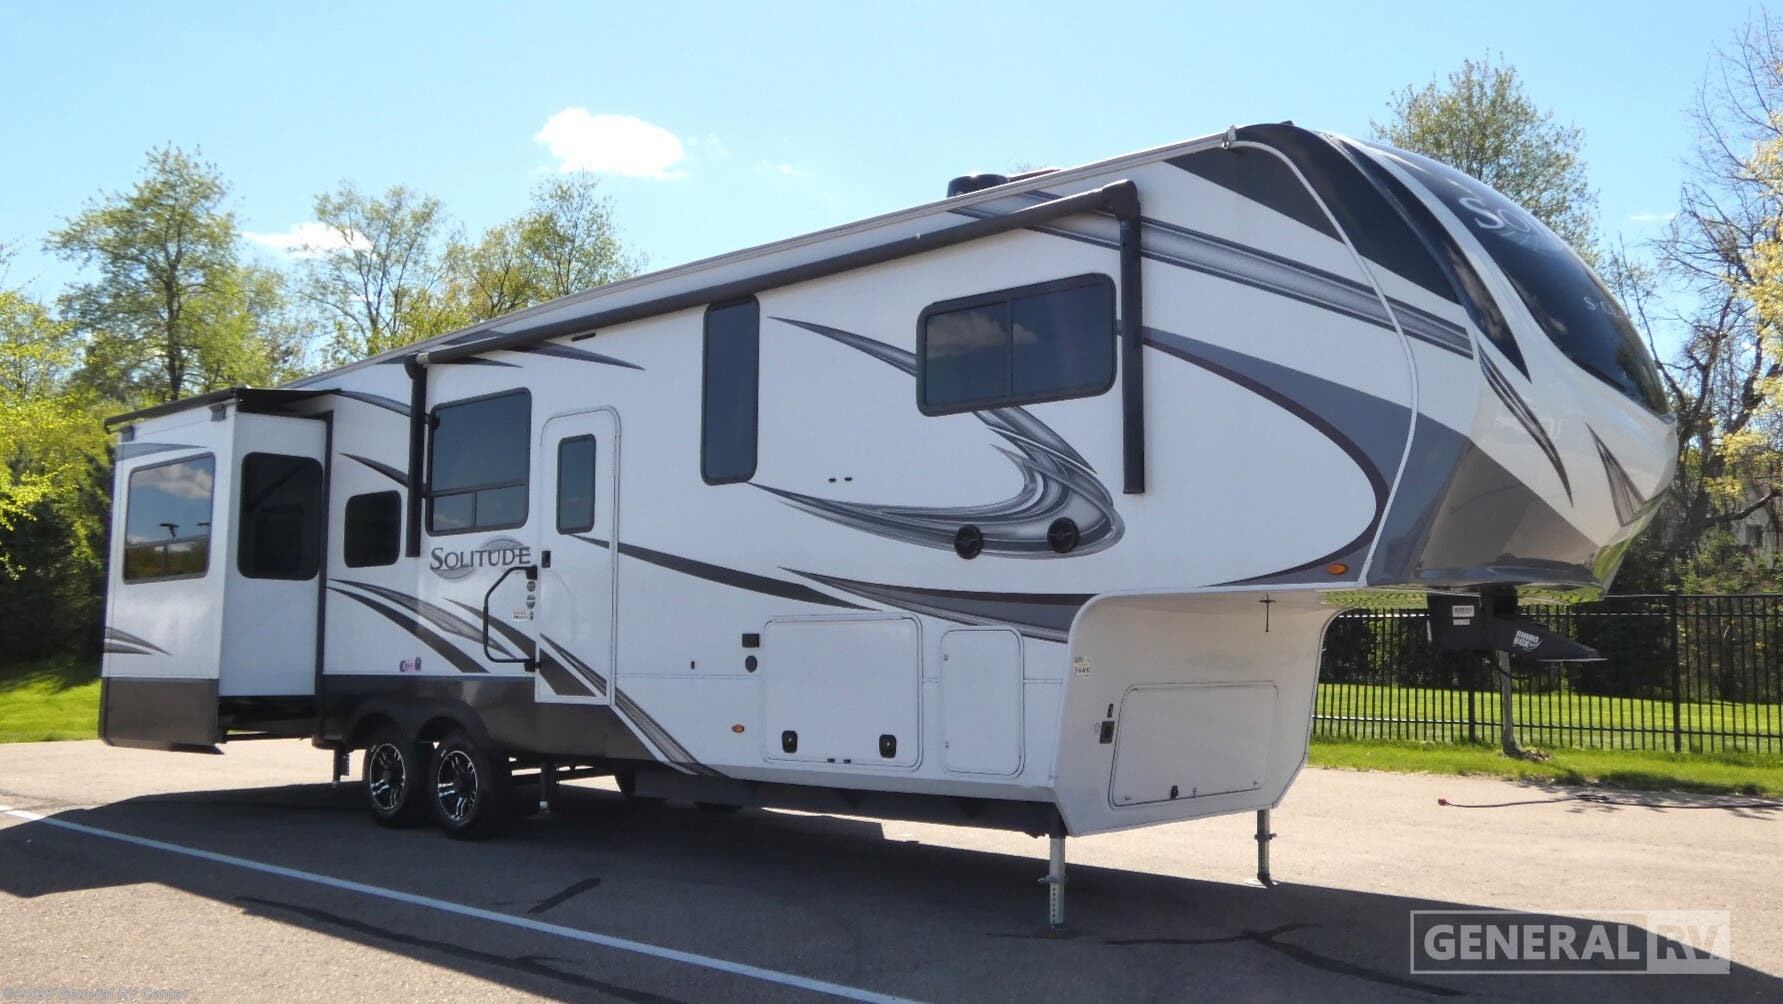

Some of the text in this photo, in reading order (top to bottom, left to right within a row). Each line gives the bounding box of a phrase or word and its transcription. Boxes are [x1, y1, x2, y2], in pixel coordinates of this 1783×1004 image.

[430, 546, 531, 571] SOLITUDE
[1513, 637, 1530, 648] BOX
[1515, 630, 1540, 644] RHINO
